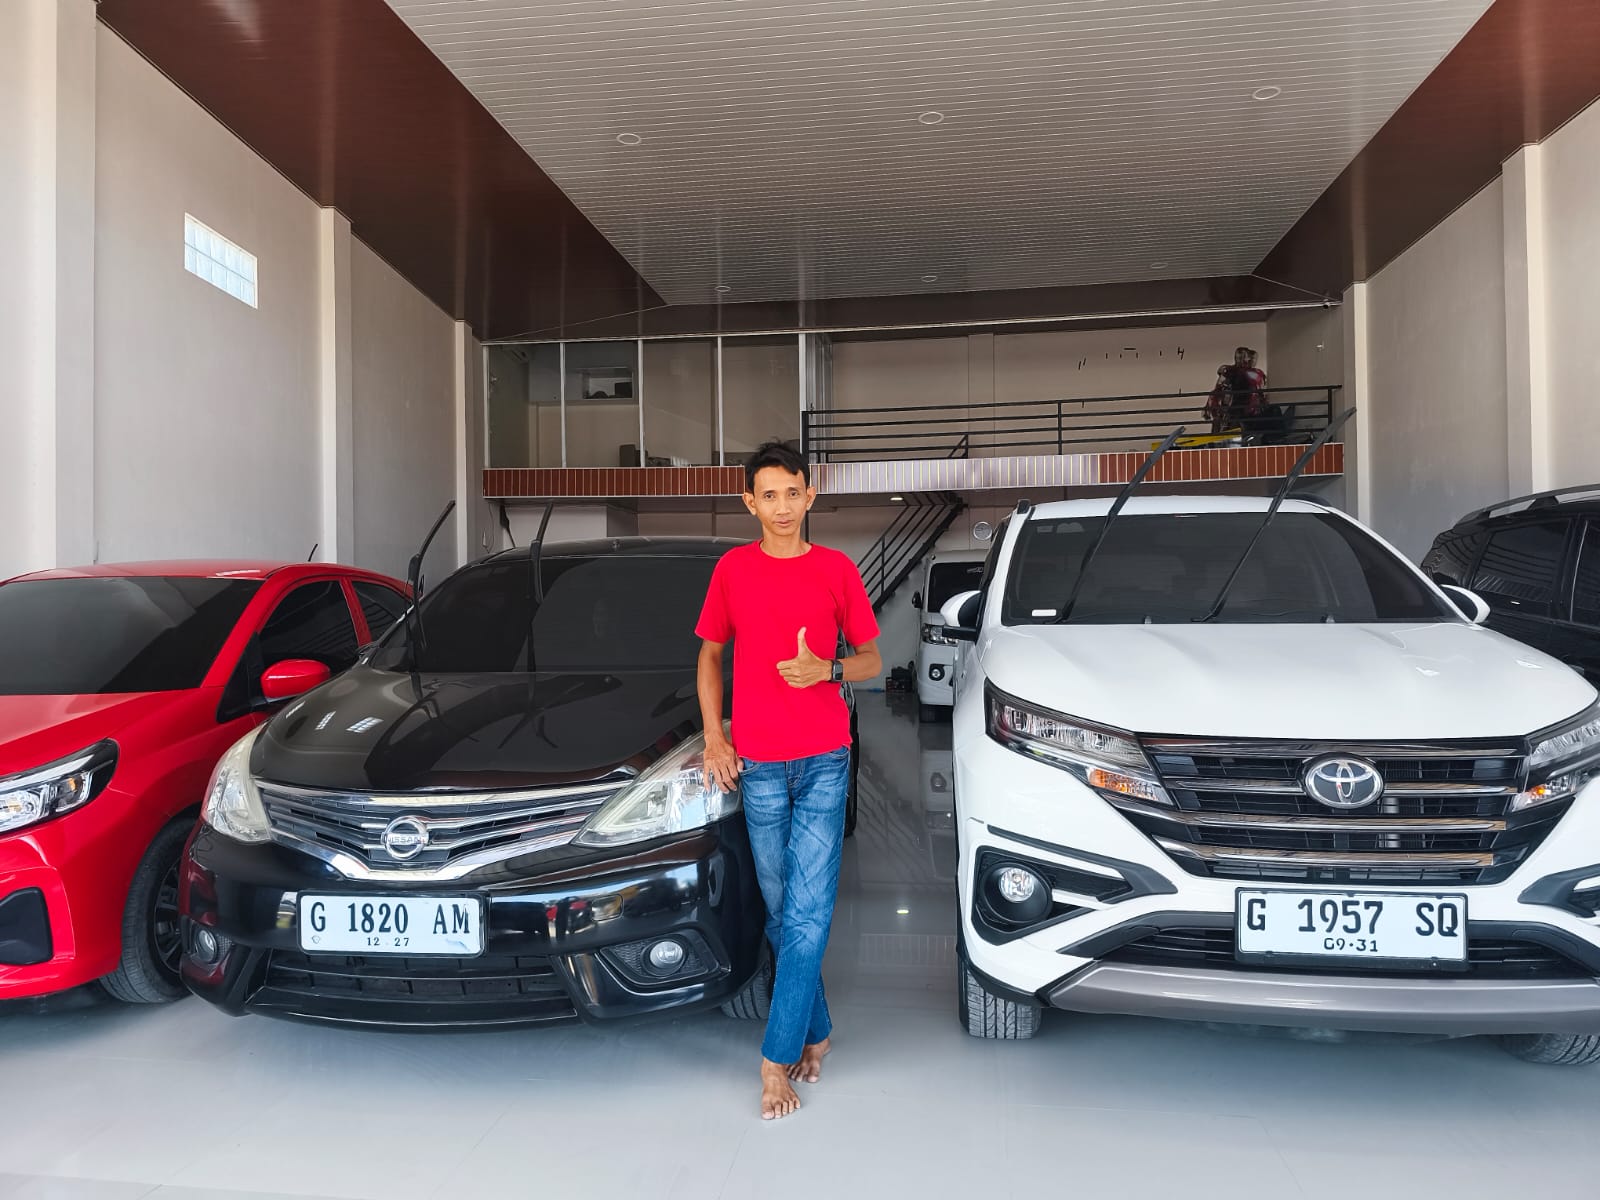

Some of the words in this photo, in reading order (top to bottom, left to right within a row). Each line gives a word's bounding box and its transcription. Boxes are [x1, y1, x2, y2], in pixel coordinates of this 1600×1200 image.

[310, 902, 326, 932] G
[347, 903, 409, 934] 1820
[432, 904, 470, 935] AM
[1247, 898, 1266, 931] G
[1297, 898, 1383, 934] 1957
[1415, 902, 1459, 937] SQ
[366, 937, 380, 946] 12
[394, 937, 410, 947] 27
